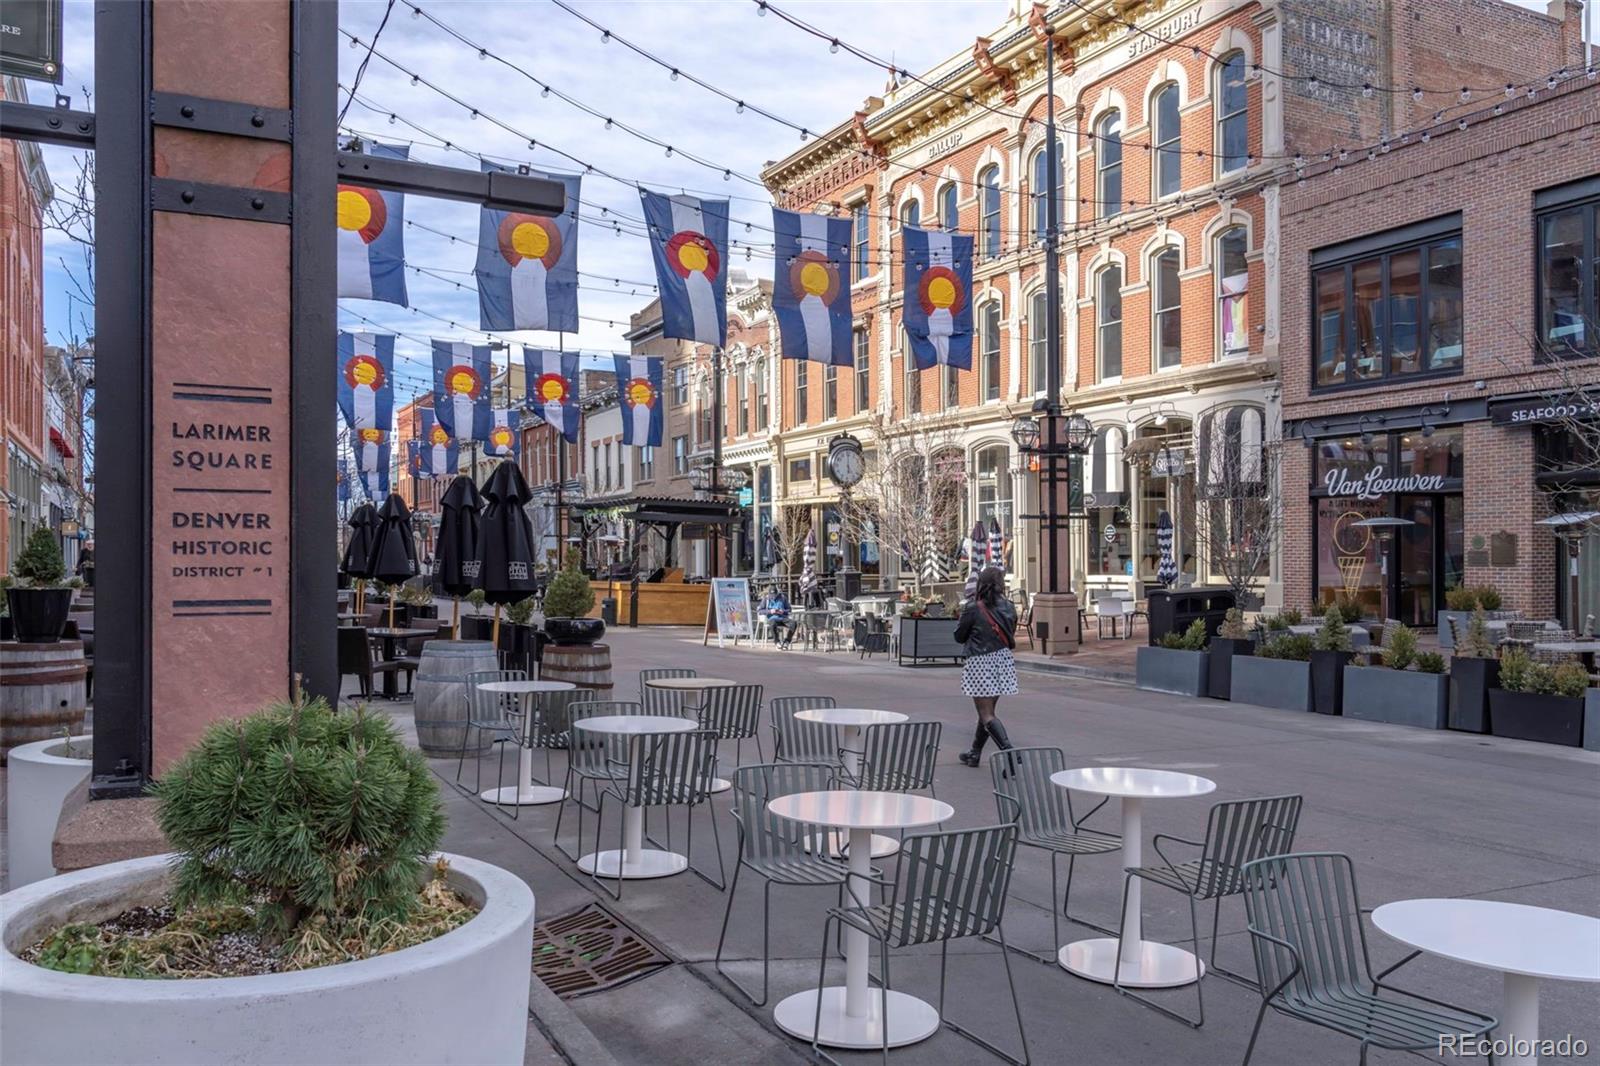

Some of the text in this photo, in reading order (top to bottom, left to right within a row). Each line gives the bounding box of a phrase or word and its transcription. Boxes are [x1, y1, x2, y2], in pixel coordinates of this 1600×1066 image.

[0, 24, 21, 35] RE
[1127, 6, 1203, 58] STANBURY
[928, 131, 963, 159] GALLUP
[1511, 404, 1577, 422] SEAFOOD
[172, 422, 271, 442] LARIMER
[172, 450, 272, 471] SQUARE
[172, 512, 271, 529] DENVER
[172, 541, 272, 555] HISTORIC
[172, 566, 272, 577] DISTRICT 1
